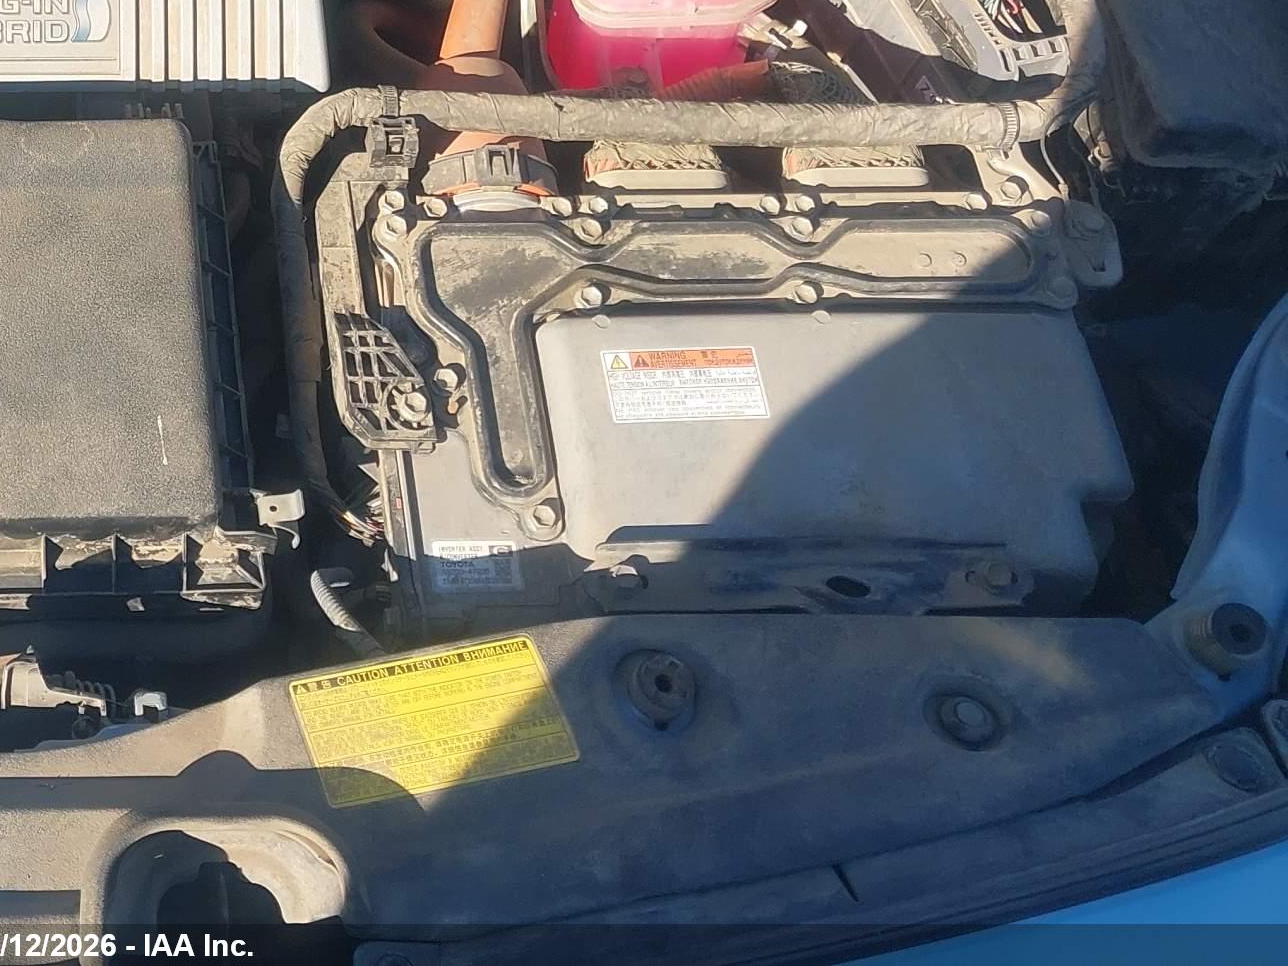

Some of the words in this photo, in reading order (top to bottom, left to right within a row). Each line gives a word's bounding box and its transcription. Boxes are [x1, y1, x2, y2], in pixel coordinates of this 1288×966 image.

[648, 351, 687, 360] WARNING
[464, 641, 528, 661] ВНИМАНИЕ
[337, 668, 389, 686] CAUTION
[394, 654, 460, 675] ATTENTION
